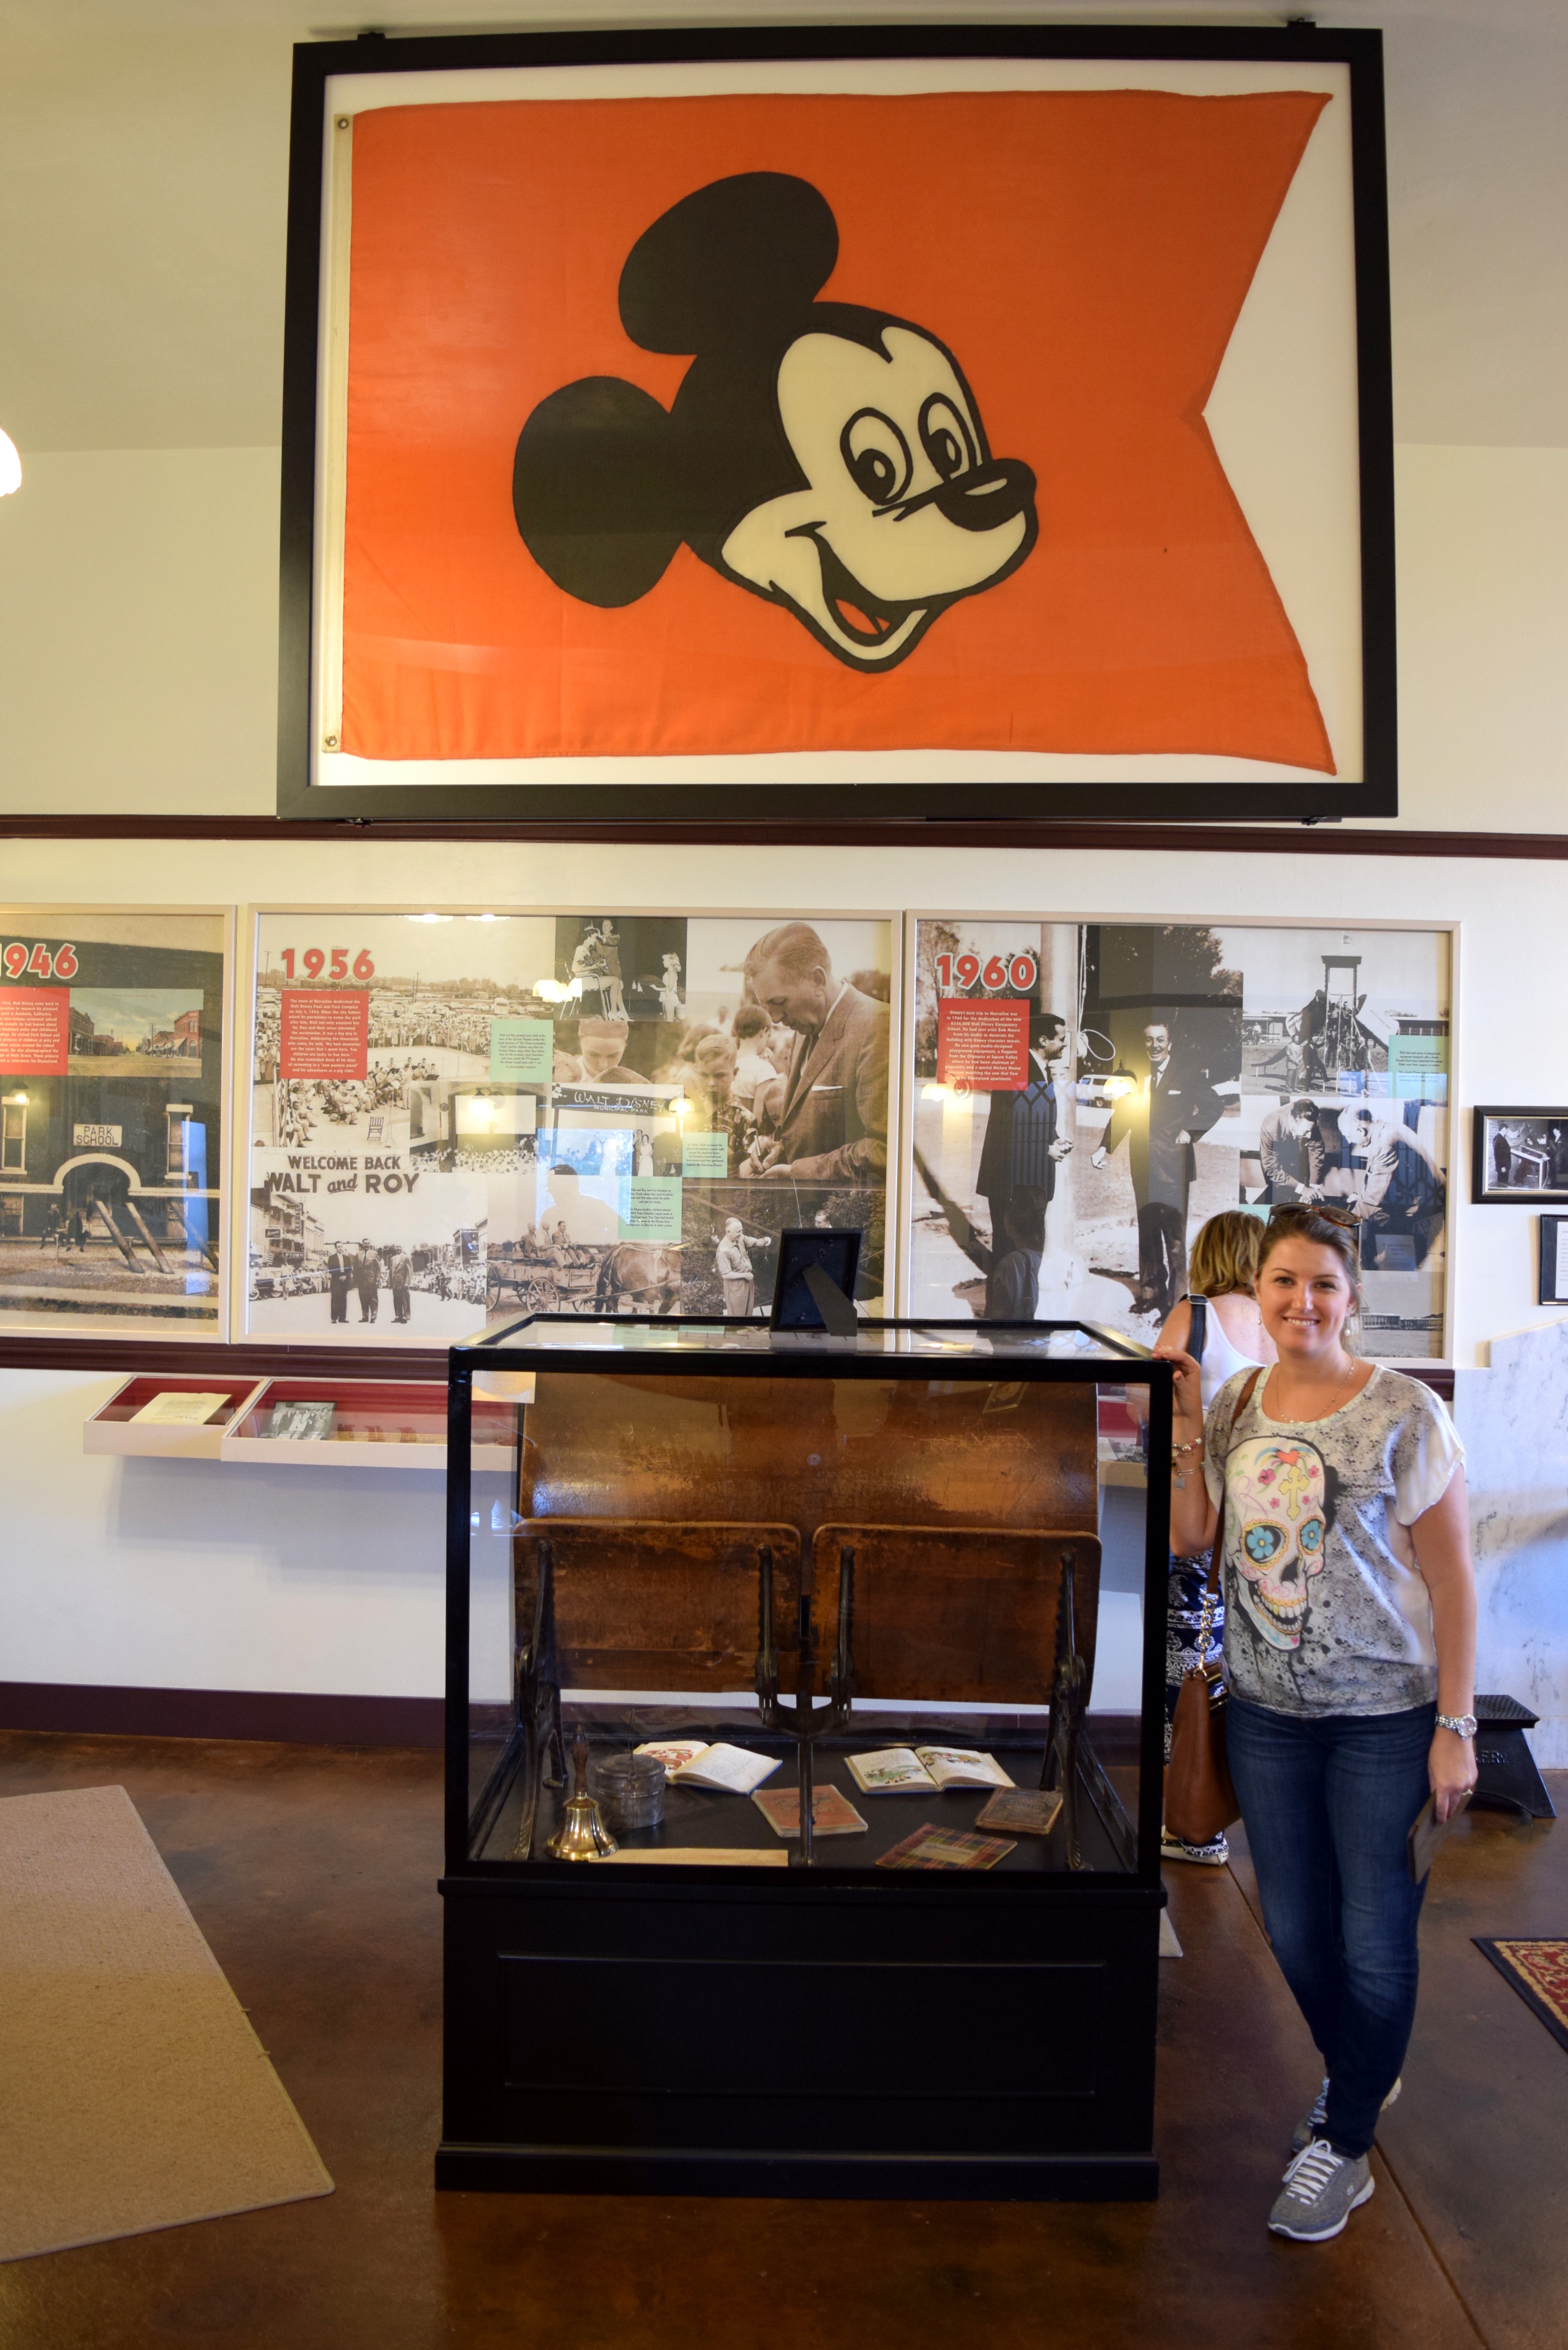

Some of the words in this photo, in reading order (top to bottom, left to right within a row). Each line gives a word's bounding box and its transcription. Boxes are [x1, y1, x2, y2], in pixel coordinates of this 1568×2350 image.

[281, 948, 375, 981] 1956
[935, 952, 1037, 991] 1960
[574, 1091, 609, 1105] WALT
[84, 1126, 112, 1136] PARK
[76, 1135, 118, 1145] SCHOOL
[288, 1156, 358, 1170] WELCOME
[365, 1156, 401, 1170] BACK
[268, 1172, 321, 1193] WALT
[327, 1173, 358, 1194] and
[365, 1173, 419, 1193] ROY
